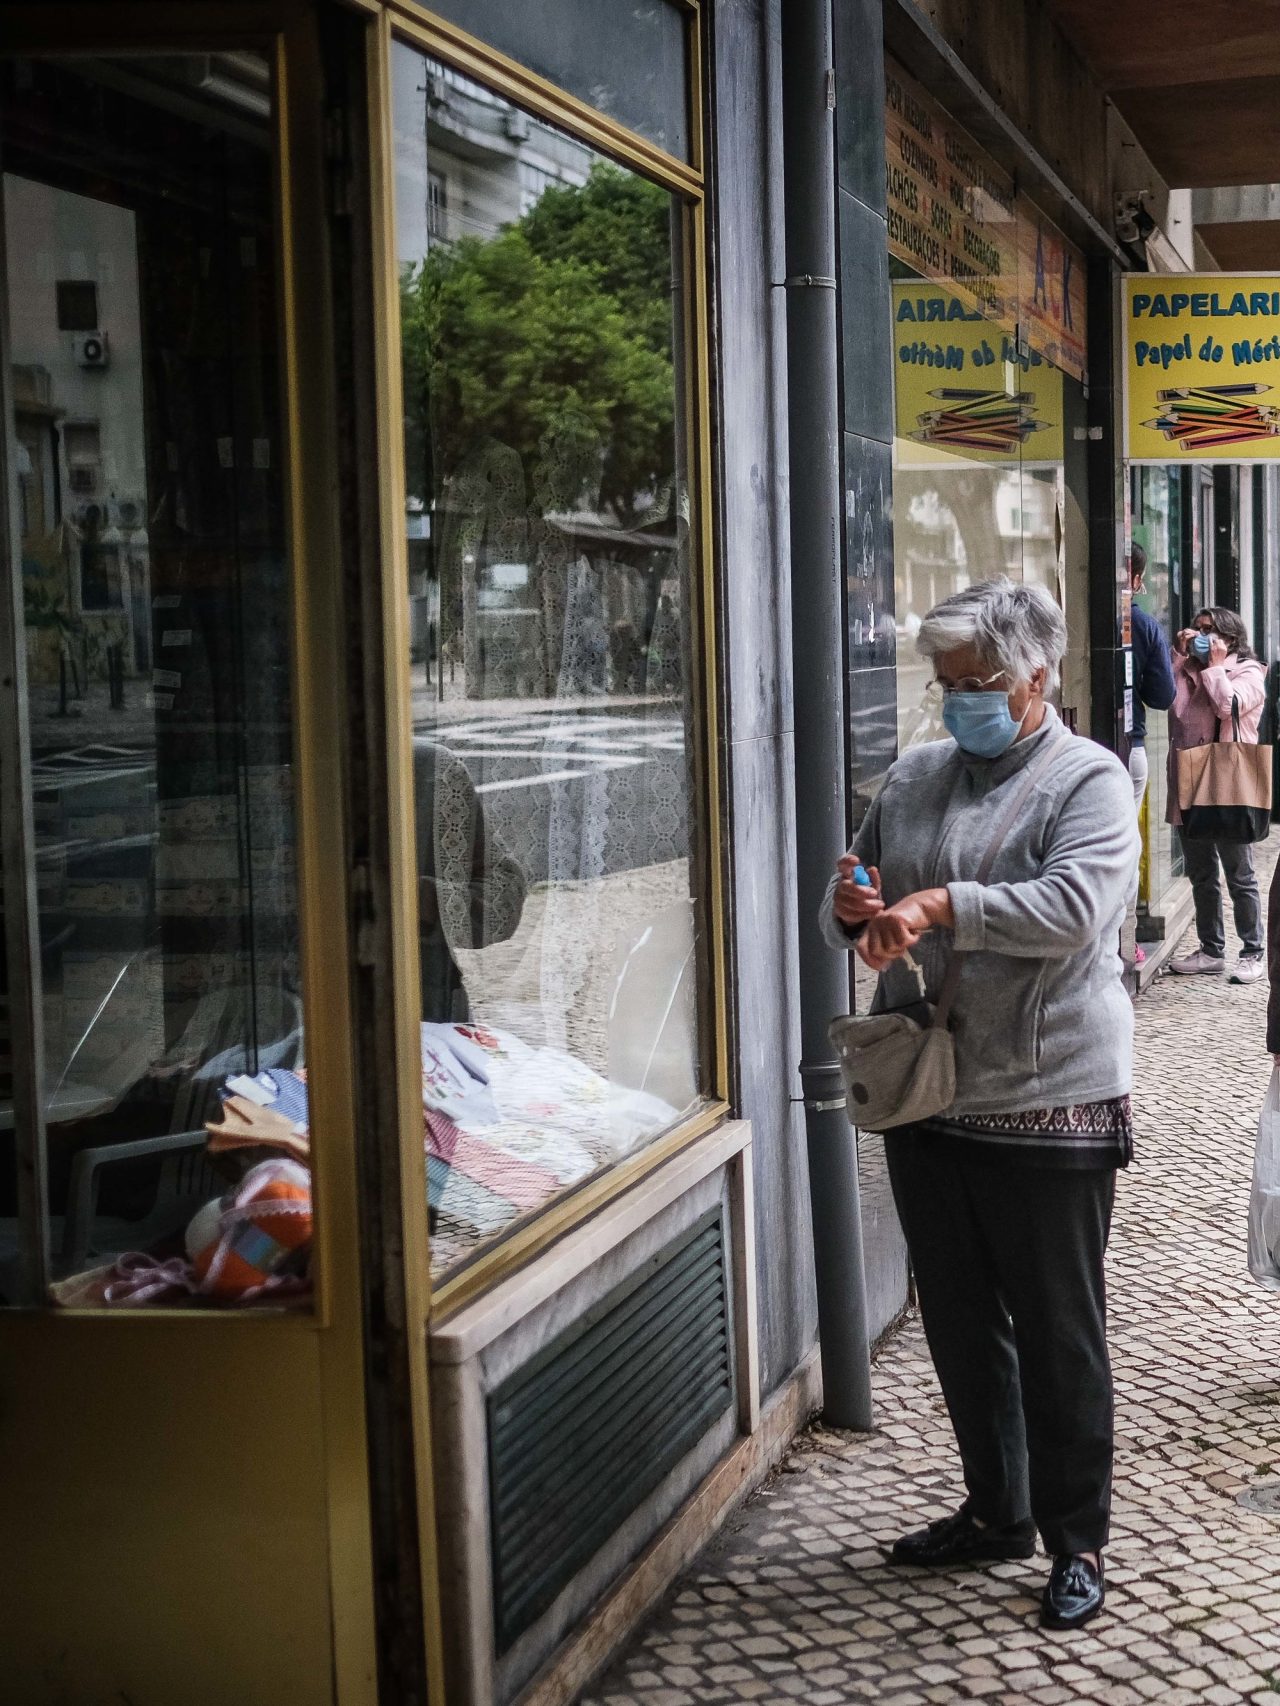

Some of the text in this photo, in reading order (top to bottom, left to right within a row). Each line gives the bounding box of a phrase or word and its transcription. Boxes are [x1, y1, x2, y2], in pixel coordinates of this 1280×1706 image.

[900, 130, 938, 189] COZINHAS
[1135, 333, 1192, 370] Papel
[1198, 335, 1224, 363] de
